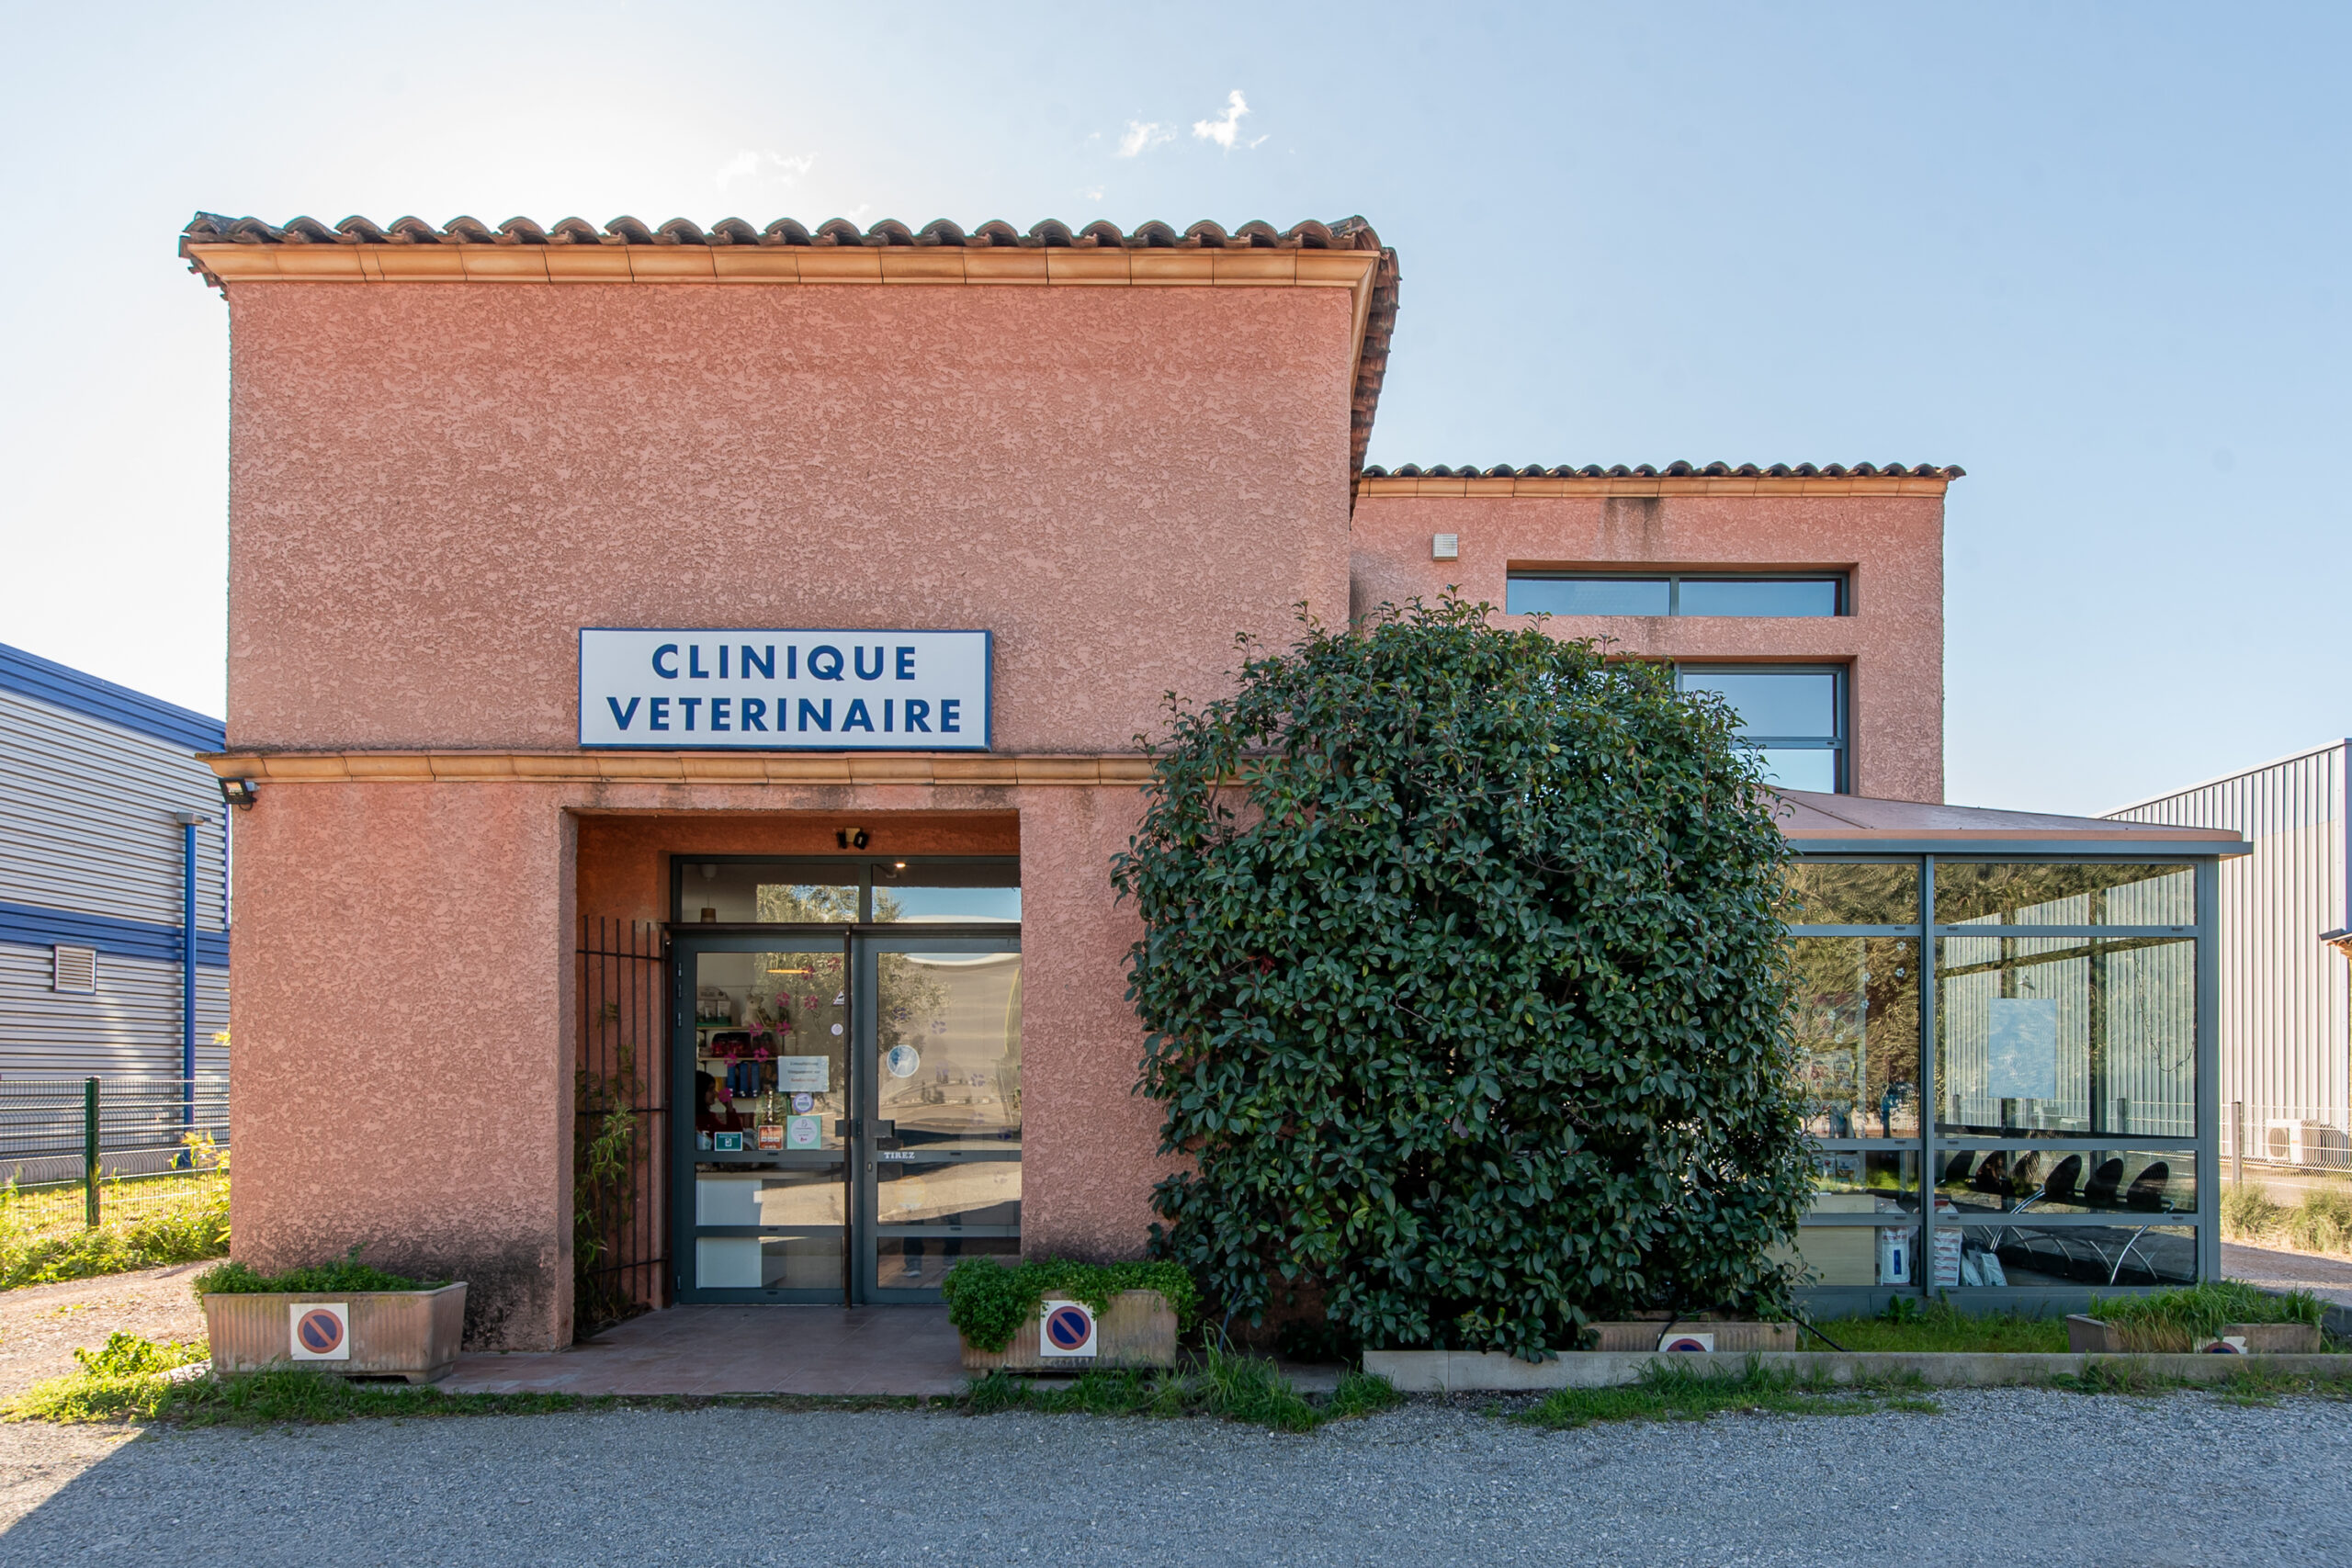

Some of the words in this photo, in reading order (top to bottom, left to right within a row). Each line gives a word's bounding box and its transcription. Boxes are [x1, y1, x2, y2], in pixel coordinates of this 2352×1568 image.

[651, 643, 916, 682] CLINIQUE
[605, 696, 961, 733] VETERINAIRE
[884, 1151, 915, 1159] TIREZ
